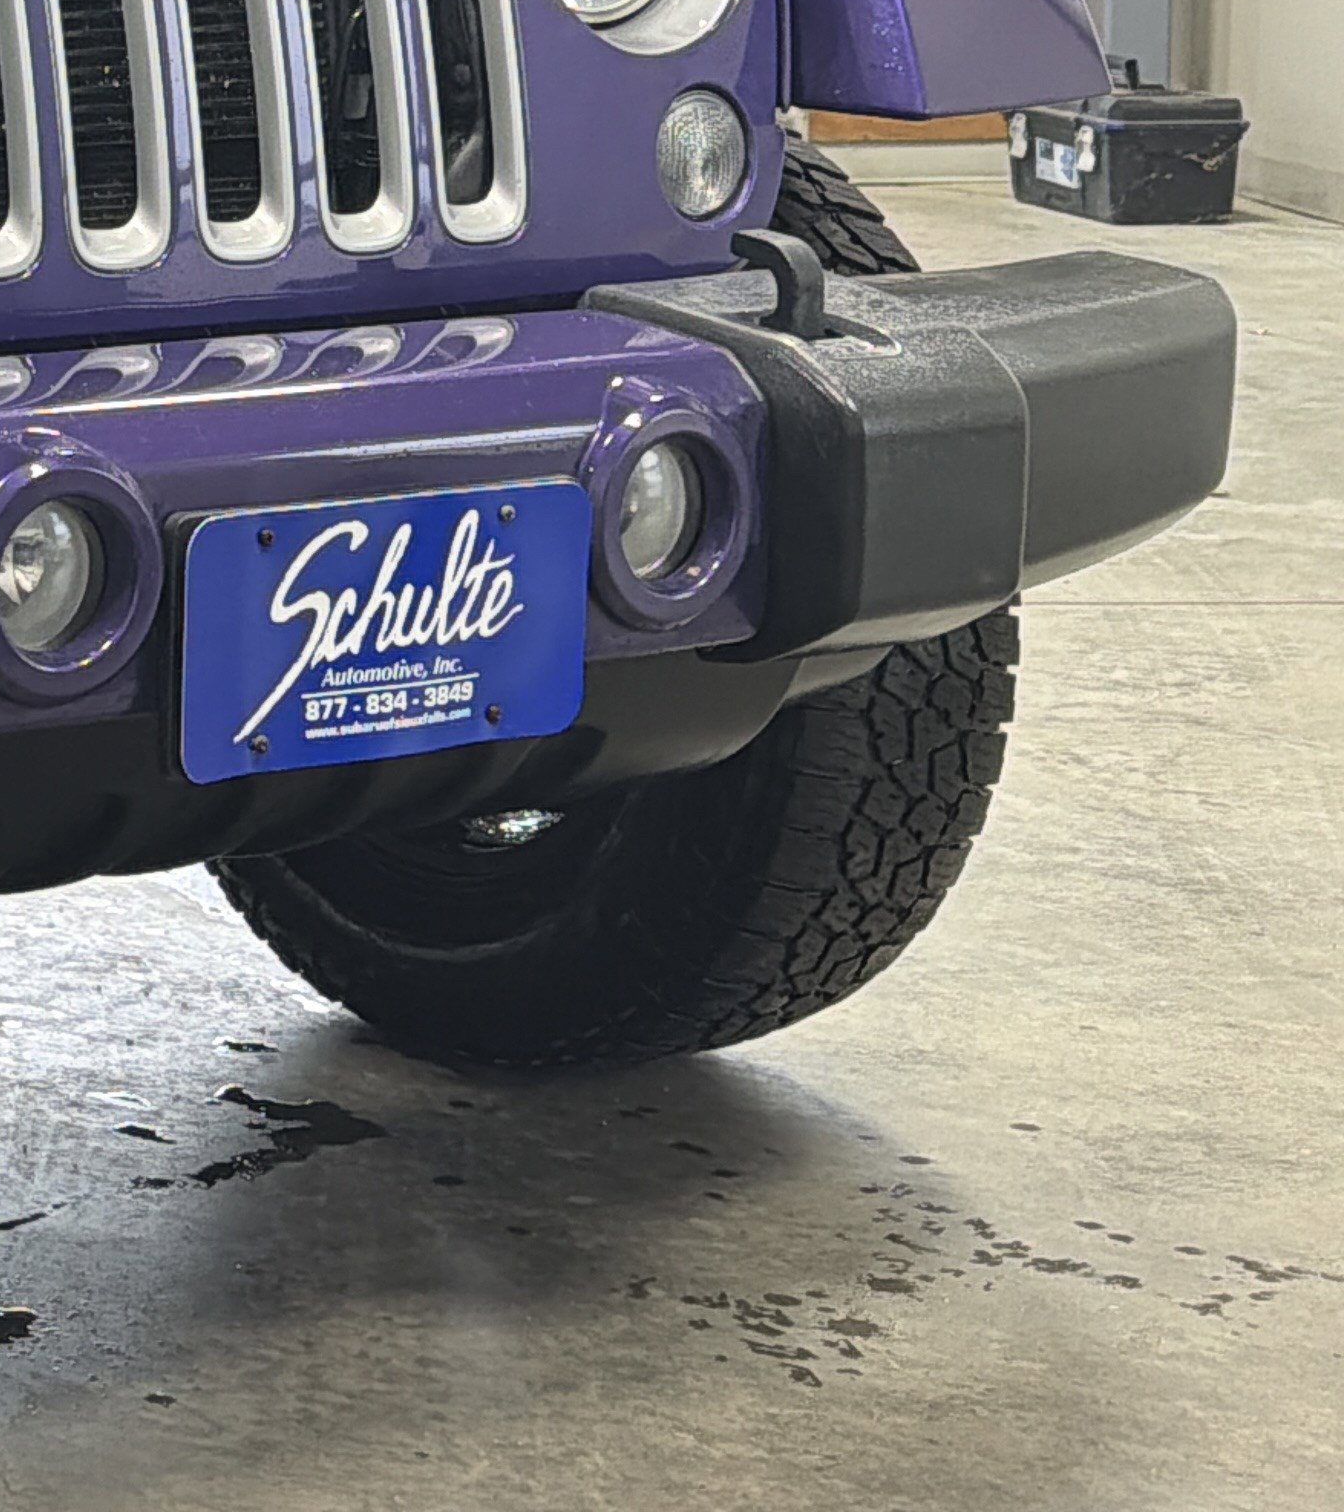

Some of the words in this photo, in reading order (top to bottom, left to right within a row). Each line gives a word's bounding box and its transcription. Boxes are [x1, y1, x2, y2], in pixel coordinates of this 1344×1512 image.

[232, 508, 524, 745] Schulte
[320, 658, 428, 688] Automotive,
[432, 655, 464, 676] Inc.
[304, 695, 348, 722] 877
[365, 690, 408, 715] 834
[422, 681, 474, 707] 3849
